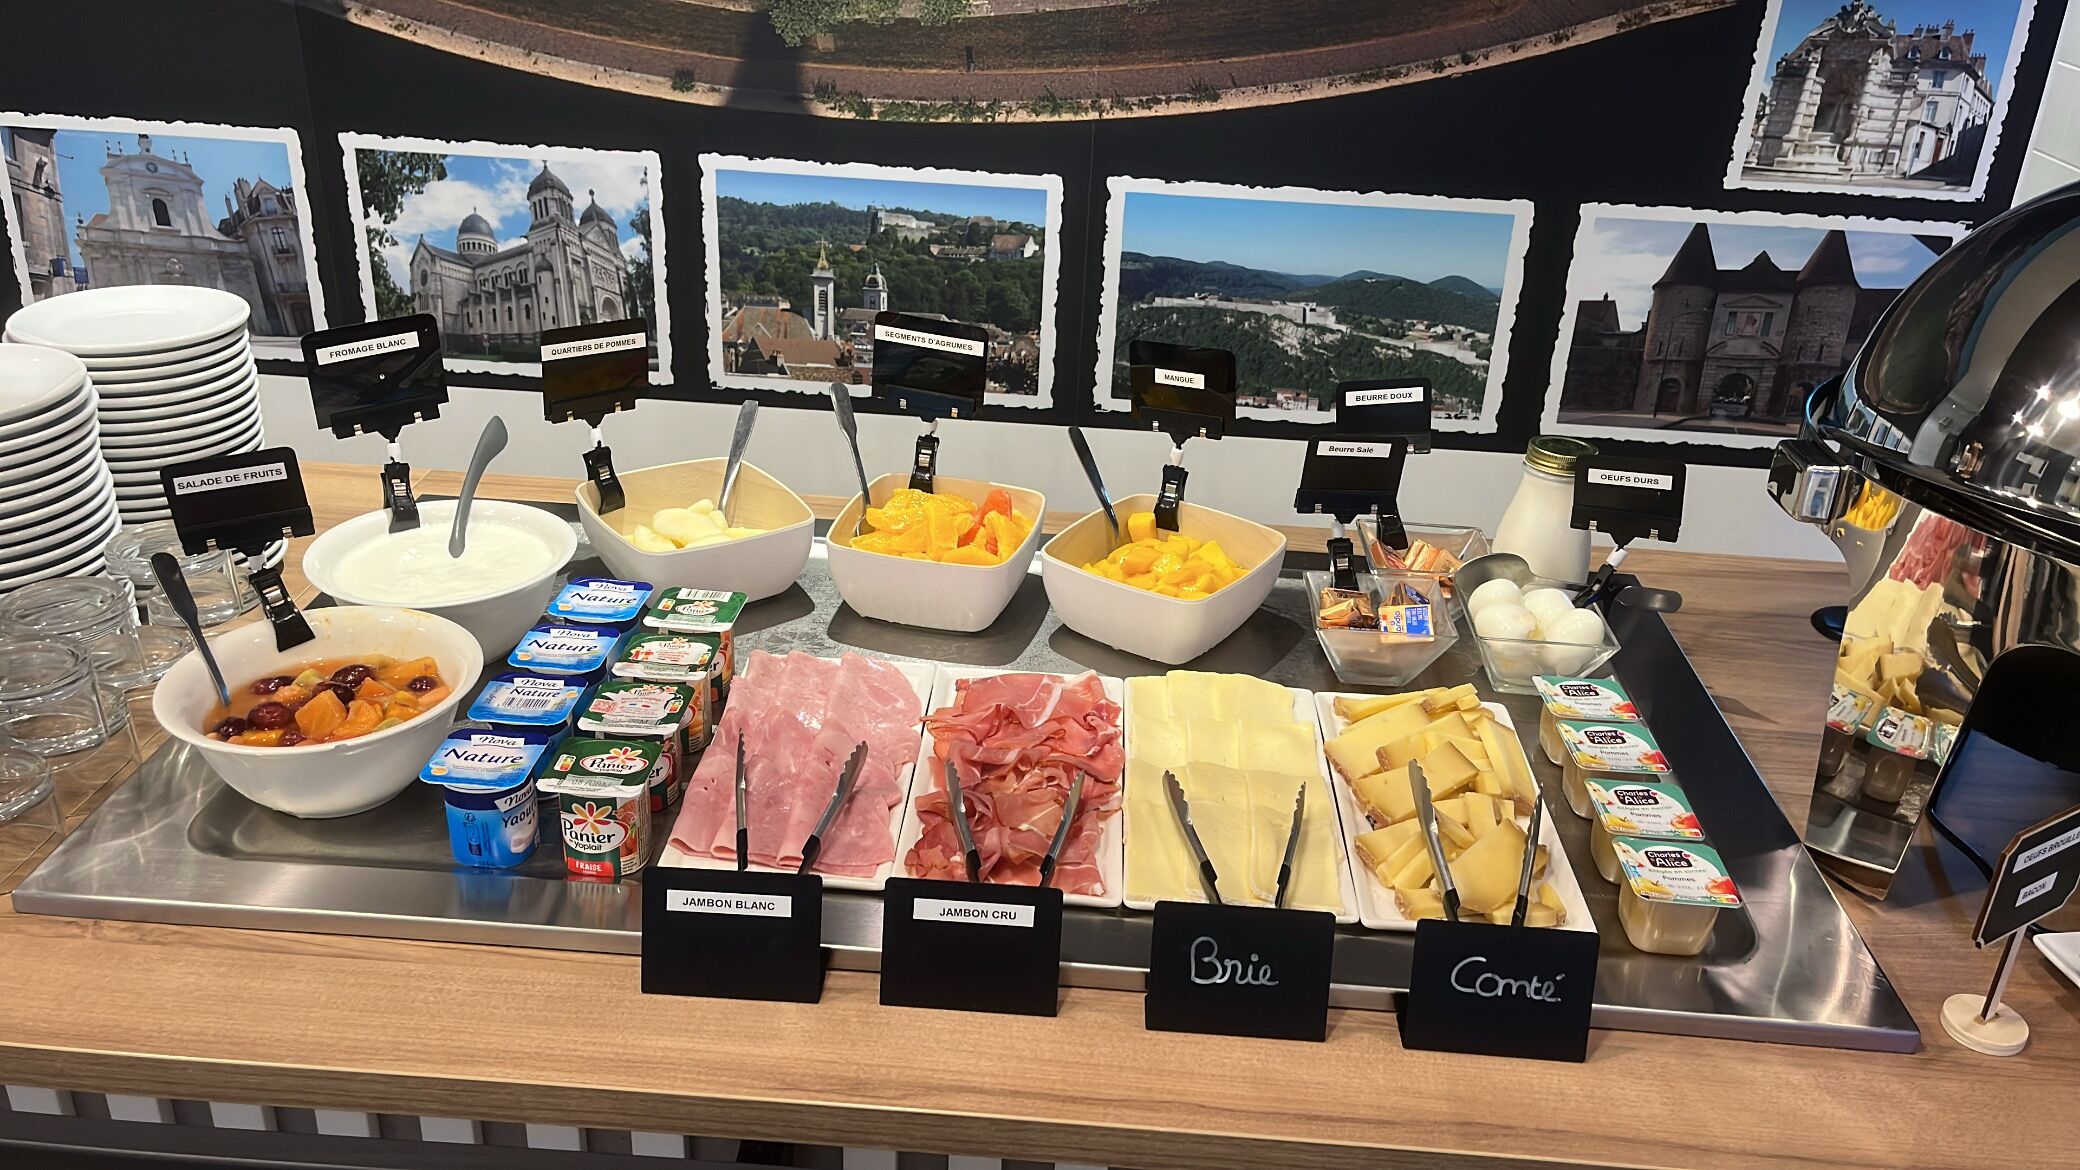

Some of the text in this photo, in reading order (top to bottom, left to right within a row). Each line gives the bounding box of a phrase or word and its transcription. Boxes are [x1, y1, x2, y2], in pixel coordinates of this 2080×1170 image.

[551, 338, 636, 356] QUARTIERS DE POMMES
[885, 330, 973, 351] SEGMENTS D'AGRUMES
[329, 338, 406, 359] FROMAGE BLANC
[1164, 374, 1195, 384] MANGUE
[1355, 392, 1413, 402] BEURRE DOUX
[1328, 445, 1355, 453] Beurre
[177, 468, 283, 490] SALADE DE FRUITS
[1600, 473, 1660, 485] OEUFS DURS
[570, 592, 637, 604] Nature
[527, 639, 598, 652] Nature
[521, 678, 557, 688] Nova
[509, 688, 561, 698] Nature
[1568, 689, 1597, 697] Alice
[479, 735, 517, 746] Nova
[1594, 736, 1623, 744] Alice
[444, 748, 524, 764] Nature
[588, 757, 637, 771] Panier
[504, 785, 532, 807] Nova
[1624, 795, 1656, 804] Alice
[561, 817, 616, 844] Panier
[573, 841, 602, 851] yoplait
[1655, 857, 1689, 867] Alice
[2023, 847, 2049, 864] OEUFS
[575, 861, 602, 872] FRAISE
[2021, 881, 2048, 900] BACON
[682, 897, 775, 911] JAMBON BLANC
[939, 907, 1017, 920] JAMBON CRU
[1190, 936, 1279, 986] Brie
[1450, 956, 1566, 1003] Comté
